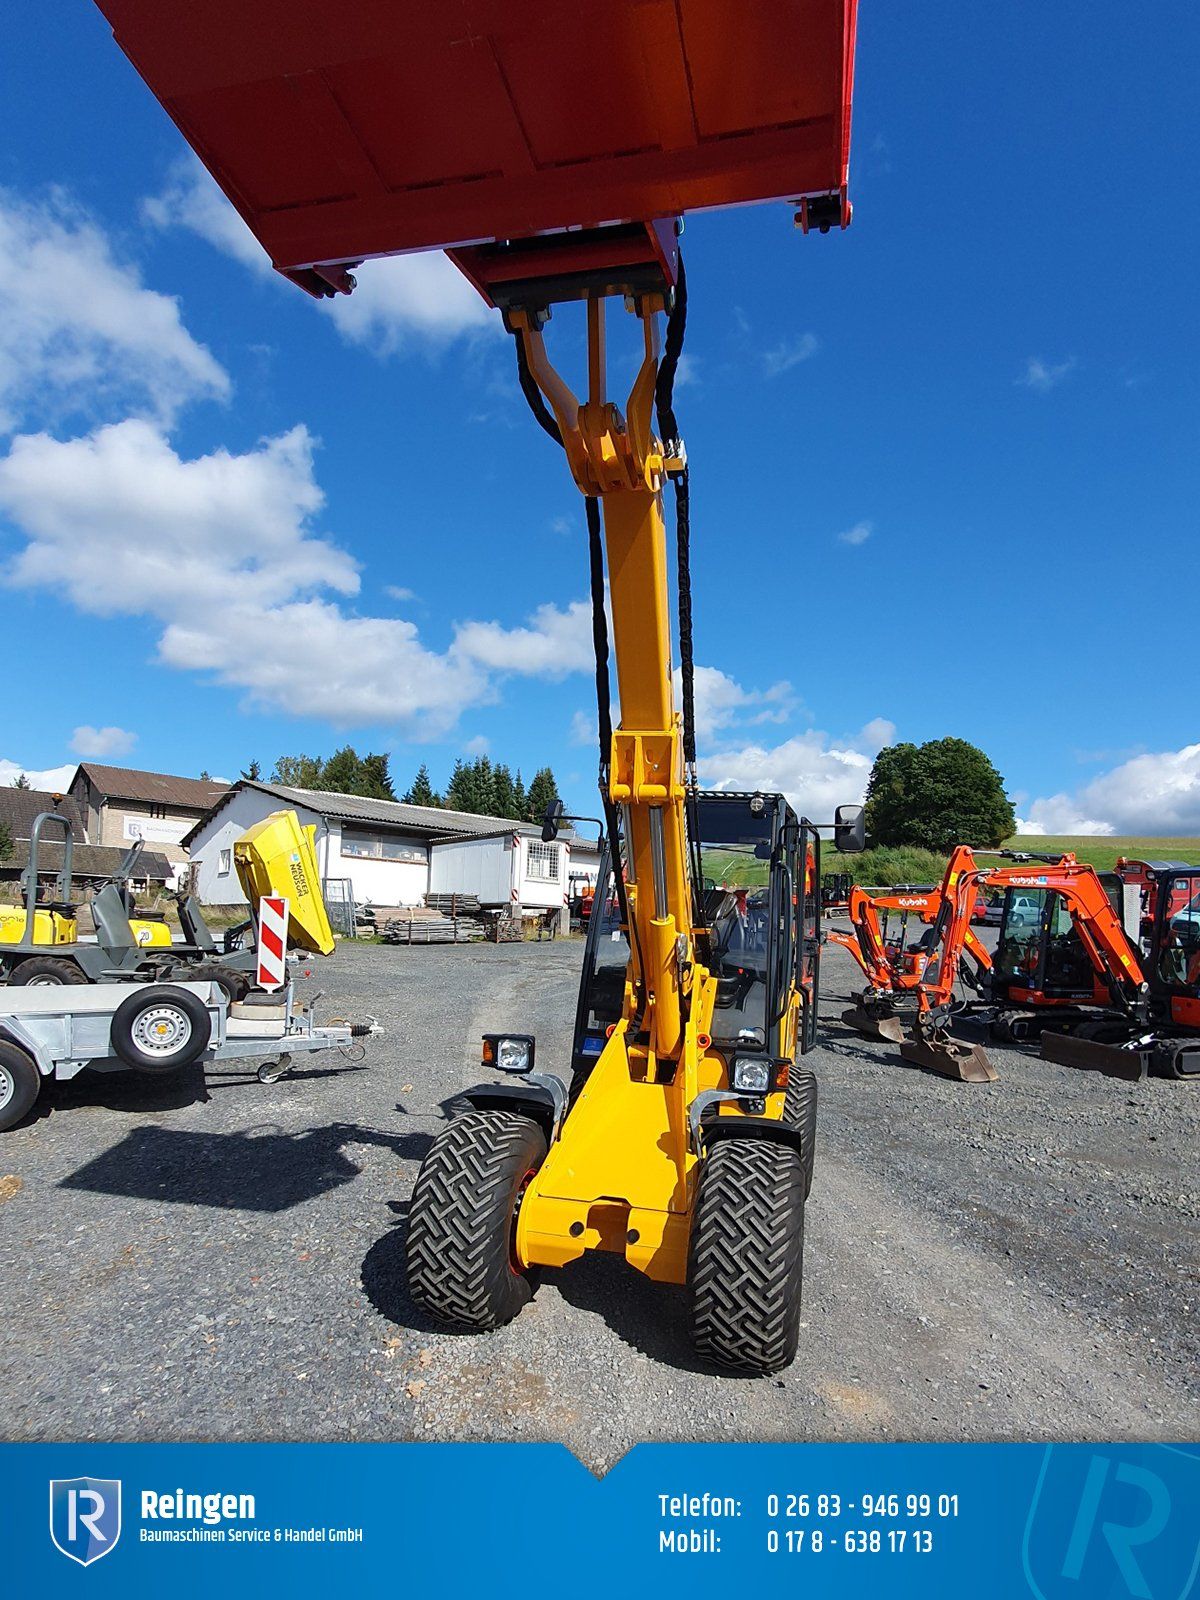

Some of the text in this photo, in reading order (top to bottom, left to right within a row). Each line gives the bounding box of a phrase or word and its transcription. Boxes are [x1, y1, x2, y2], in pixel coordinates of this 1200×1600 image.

[290, 863, 304, 897] NEUSON
[296, 861, 309, 896] WACKER
[1008, 876, 1039, 885] Kubota
[898, 897, 928, 906] Kubota
[140, 931, 150, 941] 20
